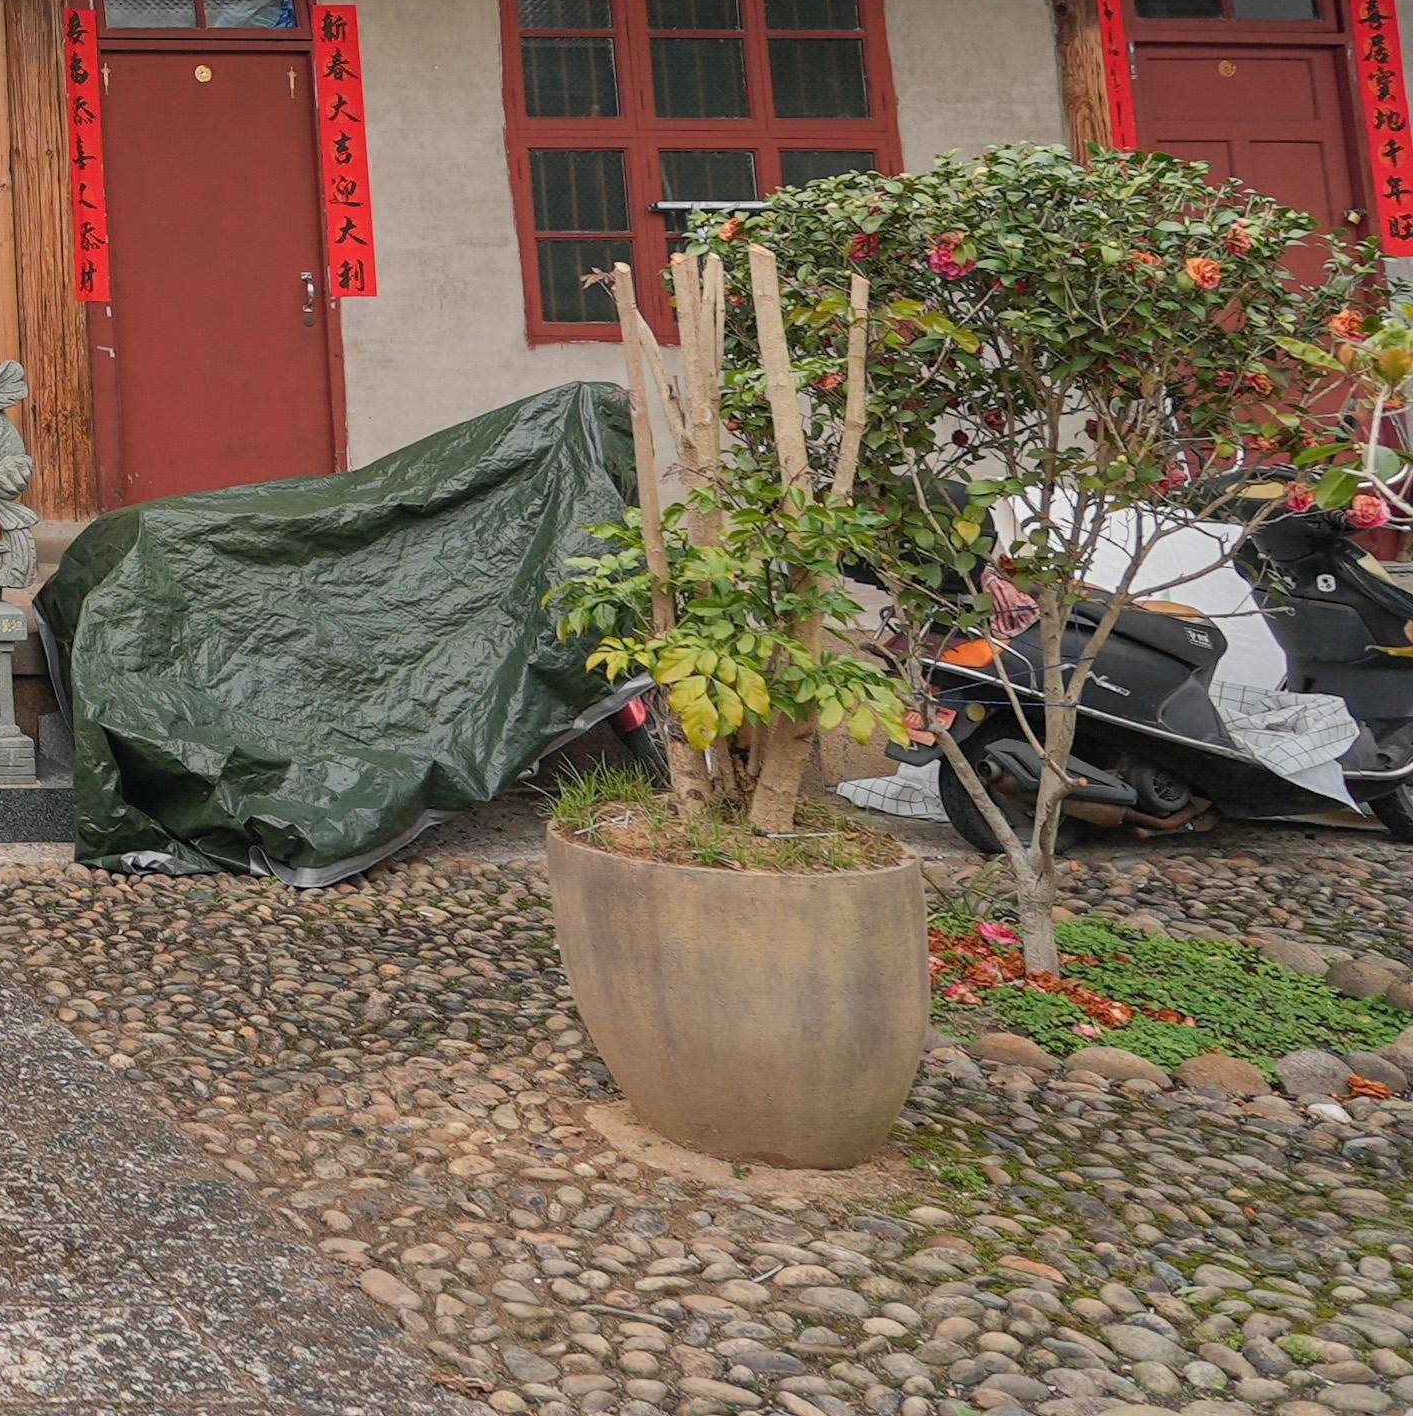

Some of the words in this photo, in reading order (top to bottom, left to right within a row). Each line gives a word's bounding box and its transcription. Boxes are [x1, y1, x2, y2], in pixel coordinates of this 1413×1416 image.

[321, 10, 369, 292] 新春大吉迎大利
